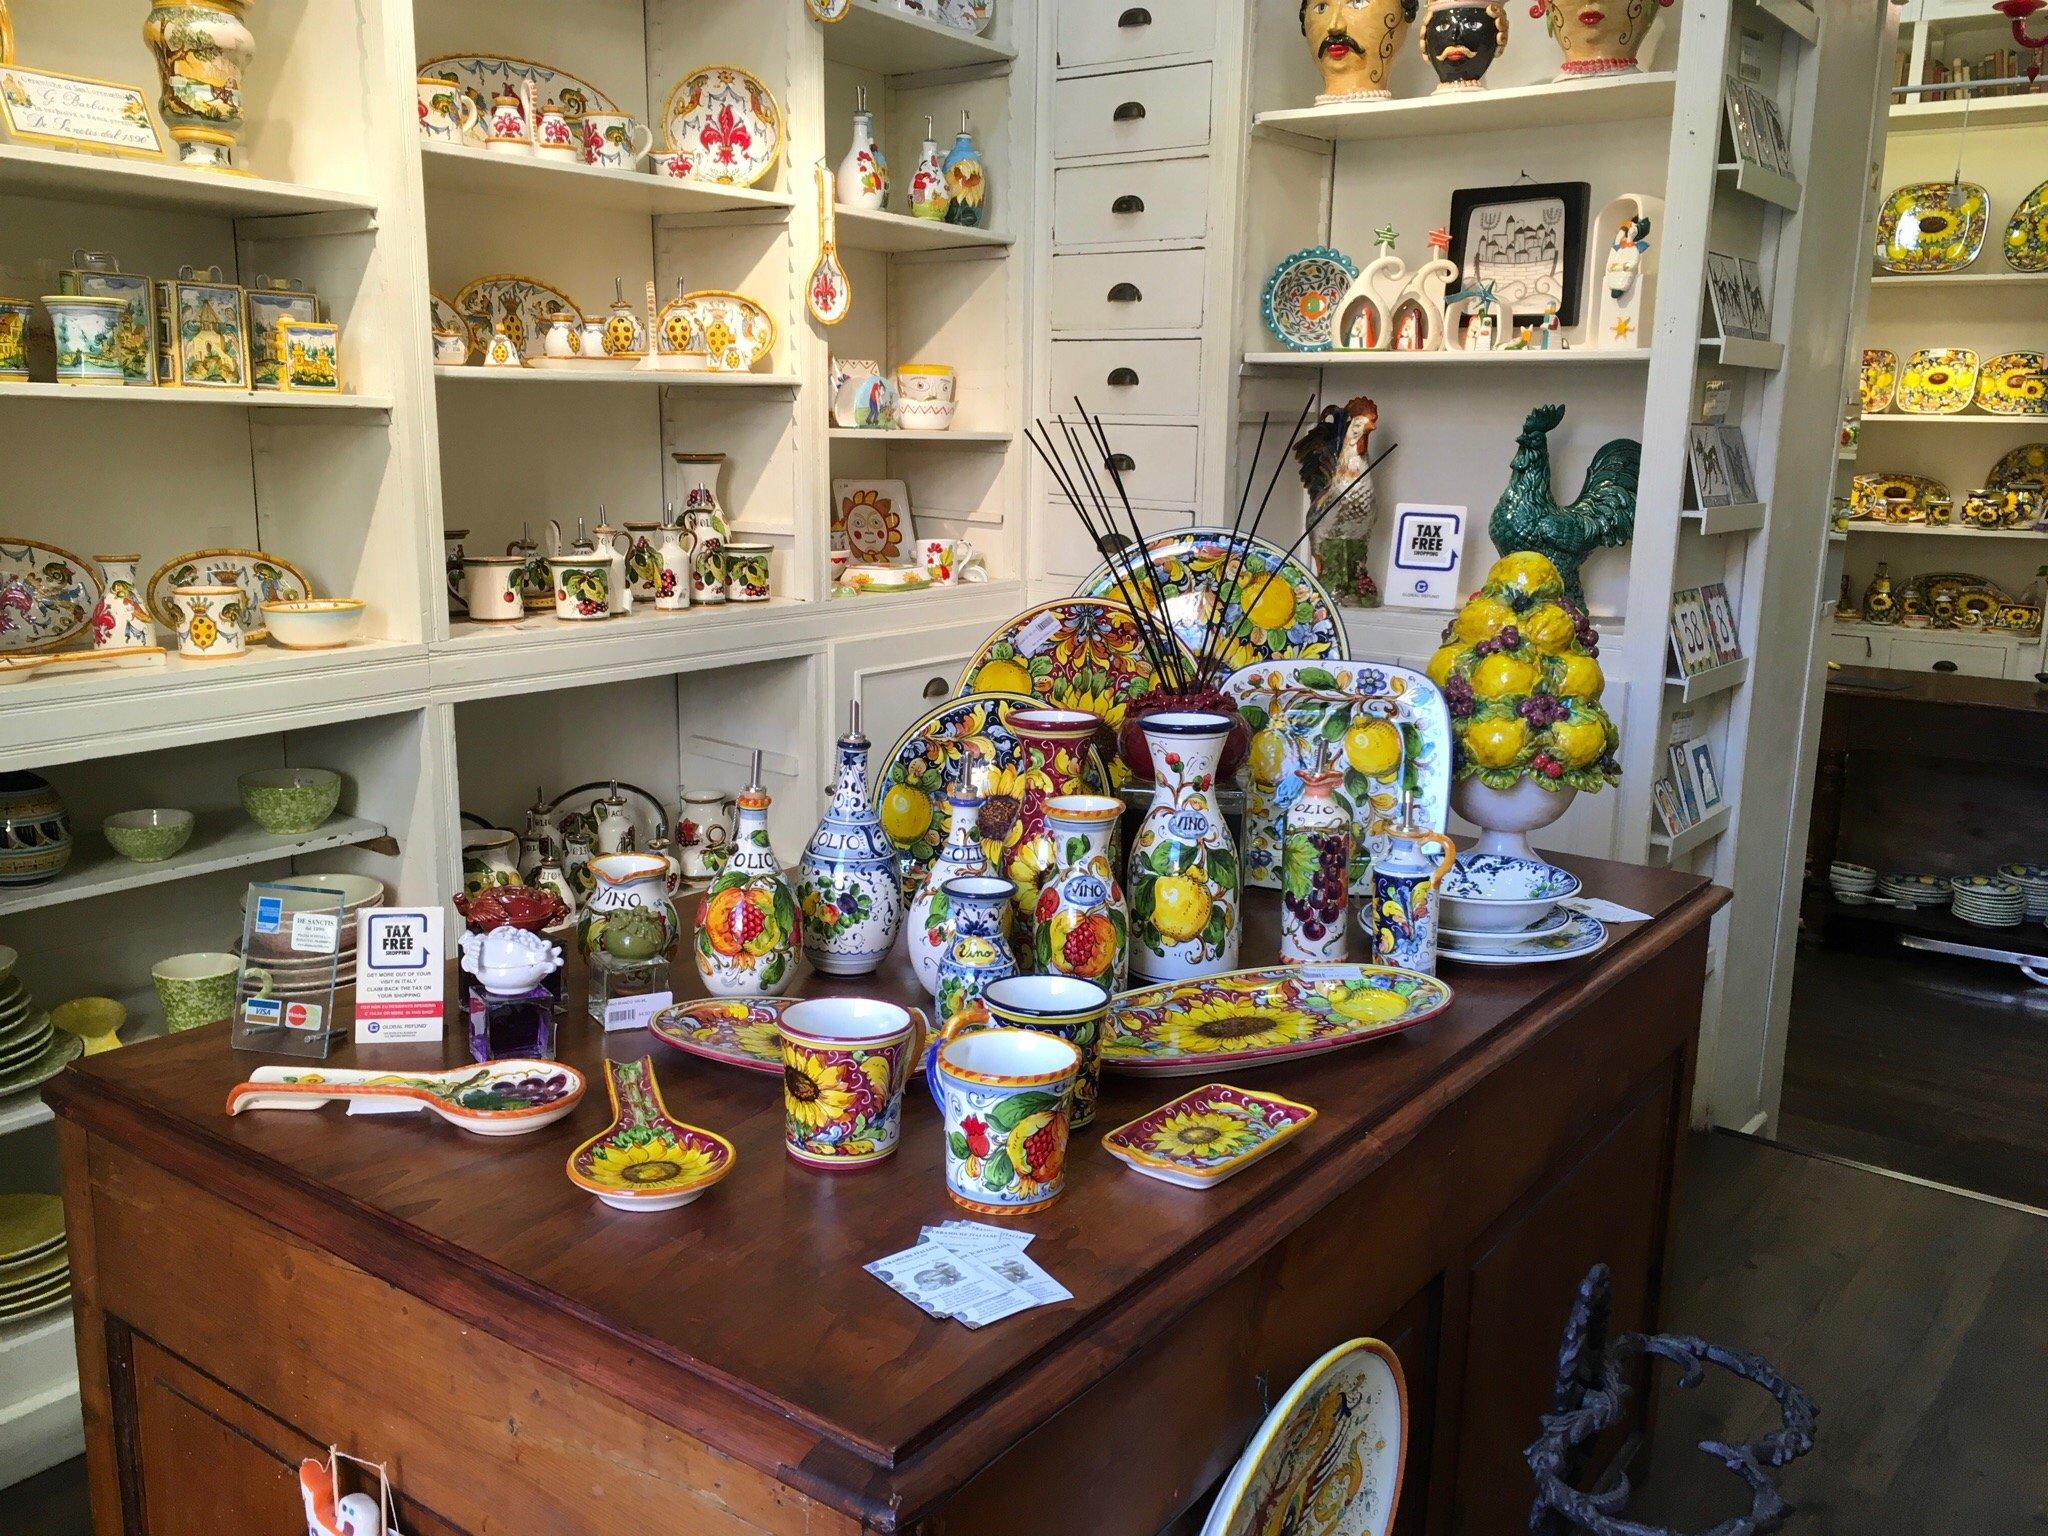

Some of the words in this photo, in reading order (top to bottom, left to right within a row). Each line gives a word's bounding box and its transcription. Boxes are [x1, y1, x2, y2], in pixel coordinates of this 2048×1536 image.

[101, 129, 122, 140] dal
[1417, 524, 1442, 538] TAX
[1411, 537, 1444, 551] FREE
[1715, 604, 1730, 644] 8
[1680, 610, 1704, 654] 58
[1294, 803, 1335, 815] OLIO
[1176, 816, 1206, 831] VINO
[817, 832, 860, 850] OLIO
[734, 852, 774, 869] OLIO
[1072, 879, 1105, 897] VINO
[594, 886, 642, 908] VINO
[307, 919, 334, 927] SANCTIS
[385, 925, 411, 938] TAX
[382, 938, 414, 950] FREE
[958, 944, 993, 958] Vino
[256, 1008, 271, 1016] VISA
